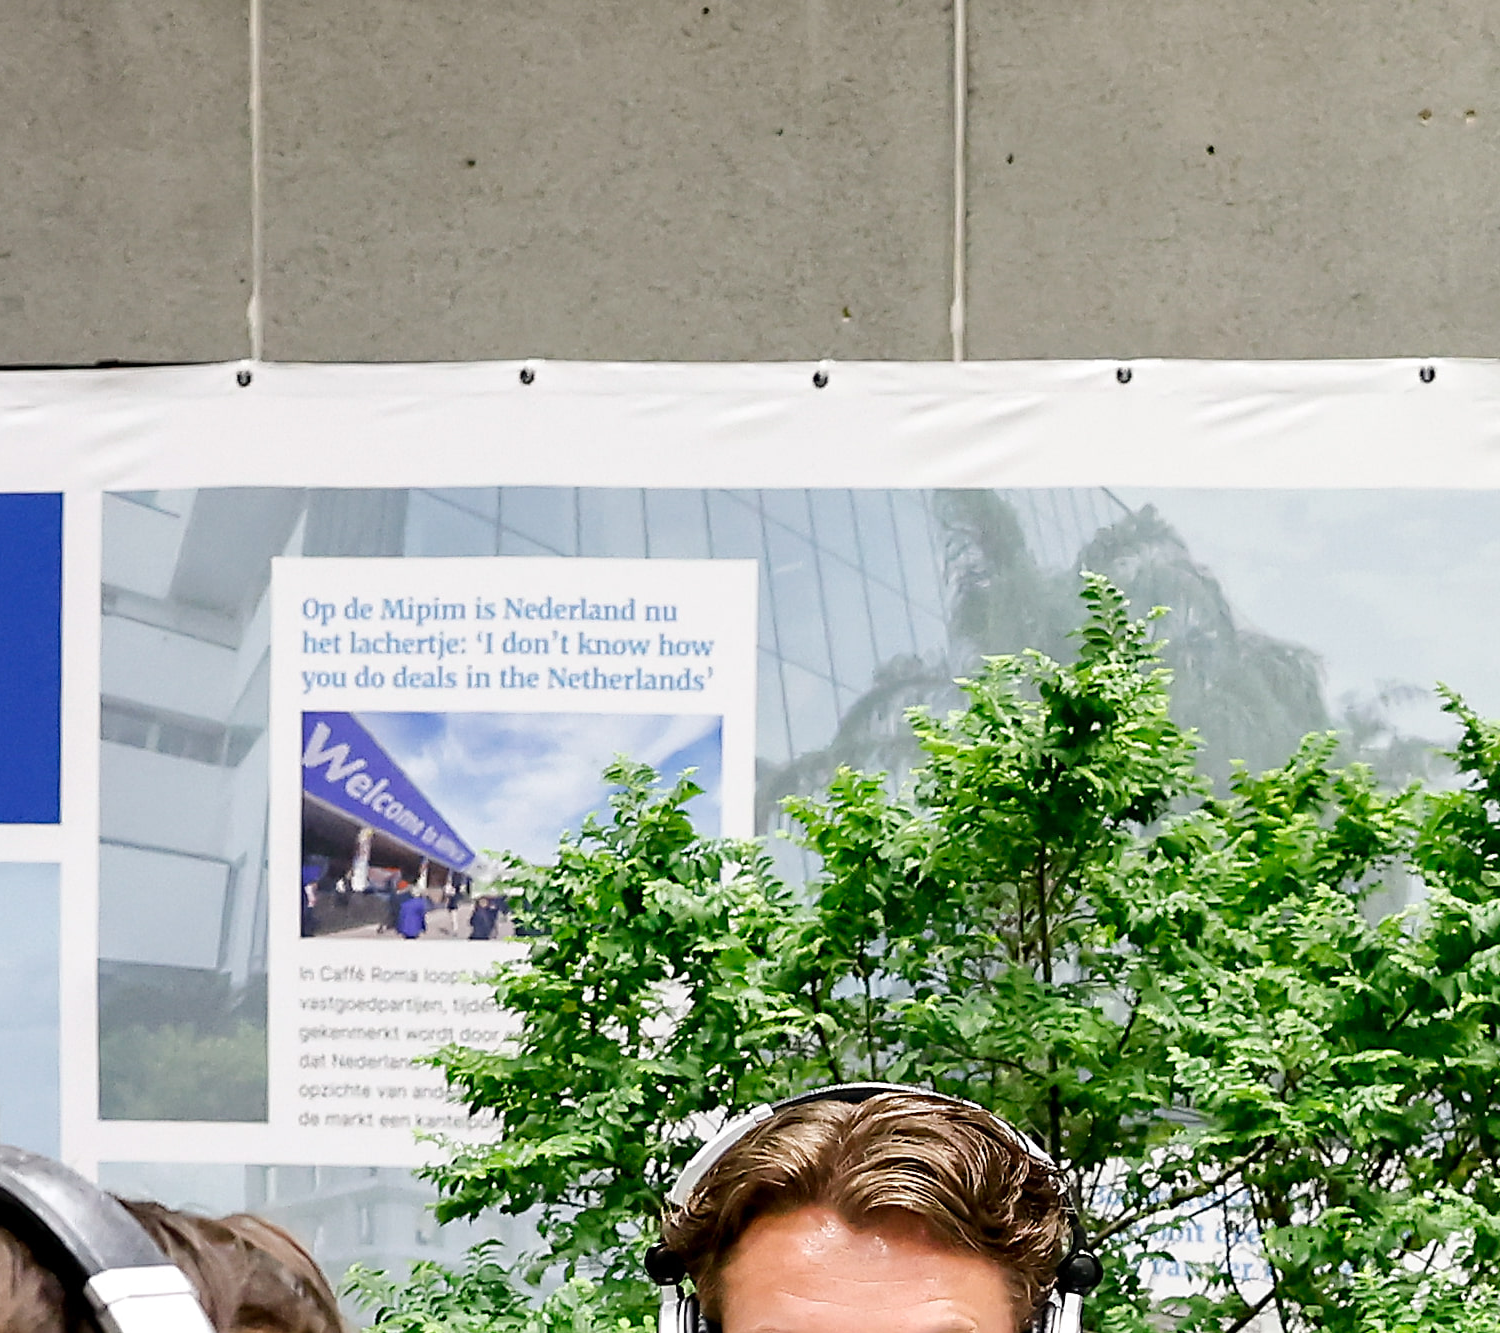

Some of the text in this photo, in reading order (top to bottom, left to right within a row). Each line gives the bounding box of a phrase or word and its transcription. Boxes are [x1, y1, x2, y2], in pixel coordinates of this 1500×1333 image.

[302, 597, 679, 627] Op de Mipim is Nederland nu
[302, 631, 342, 655] het
[350, 631, 468, 660] lachertje:
[502, 630, 570, 656] don’t
[578, 632, 651, 657] know
[659, 633, 715, 657] how
[302, 665, 714, 694] you do deals in the Netherlands’
[301, 721, 426, 836] Welcome
[371, 967, 418, 983] Roma
[459, 1029, 500, 1045] door
[377, 1086, 408, 1100] van
[298, 1112, 320, 1128] de
